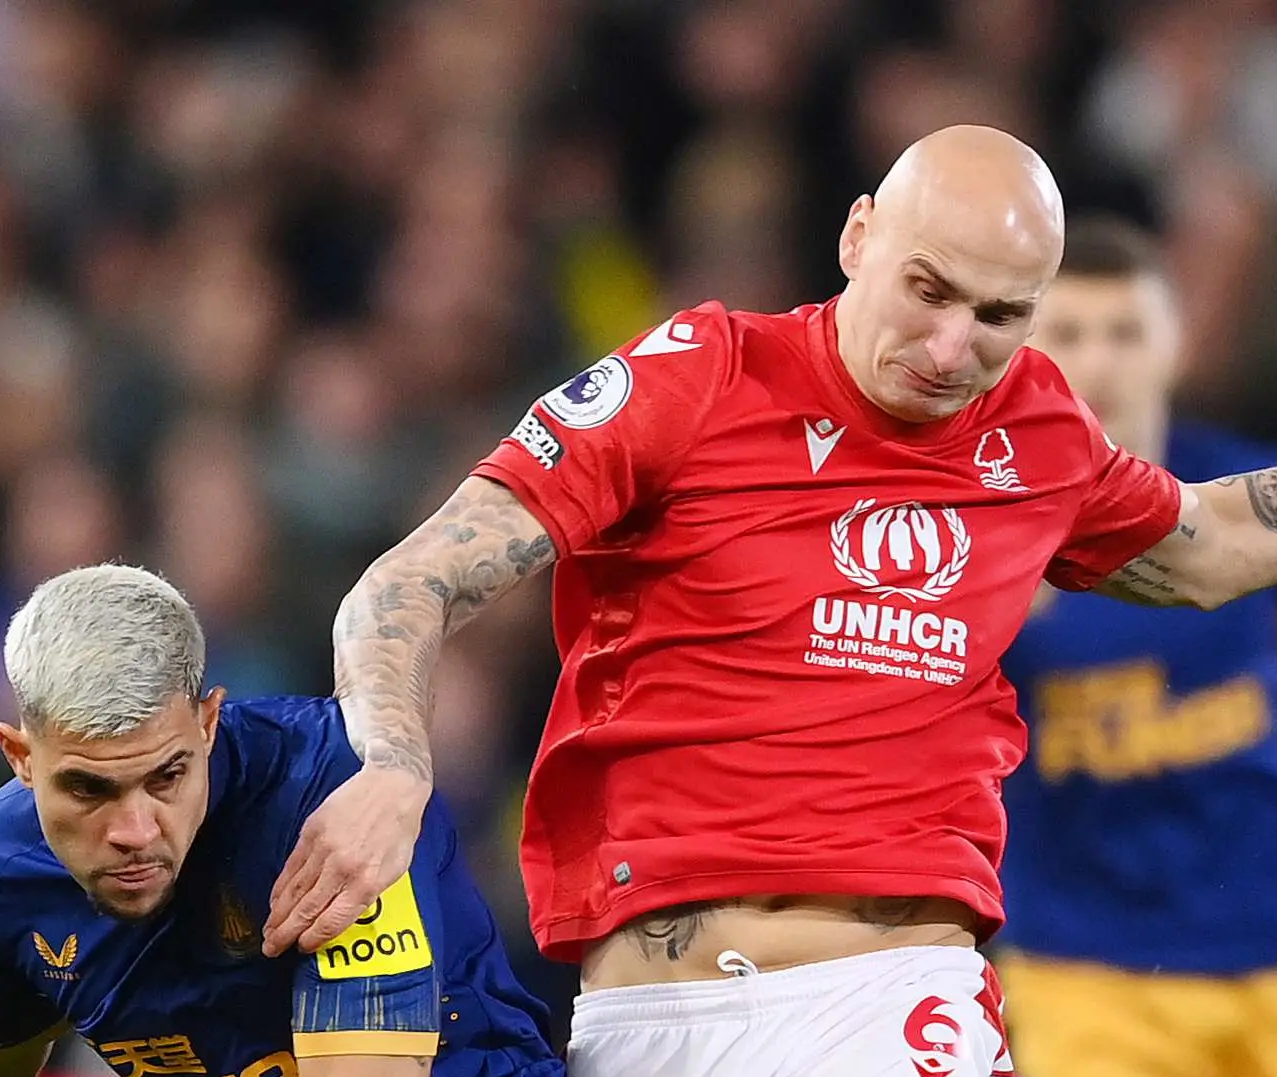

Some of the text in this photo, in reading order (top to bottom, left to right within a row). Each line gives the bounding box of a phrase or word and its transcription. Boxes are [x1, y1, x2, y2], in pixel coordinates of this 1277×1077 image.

[812, 597, 968, 657] UNHCR
[804, 651, 845, 668] United
[848, 657, 903, 675] Kingdom
[905, 666, 922, 680] for
[809, 634, 966, 673] The UN Refugee Agency
[325, 929, 419, 969] noon
[904, 995, 963, 1058] 6
